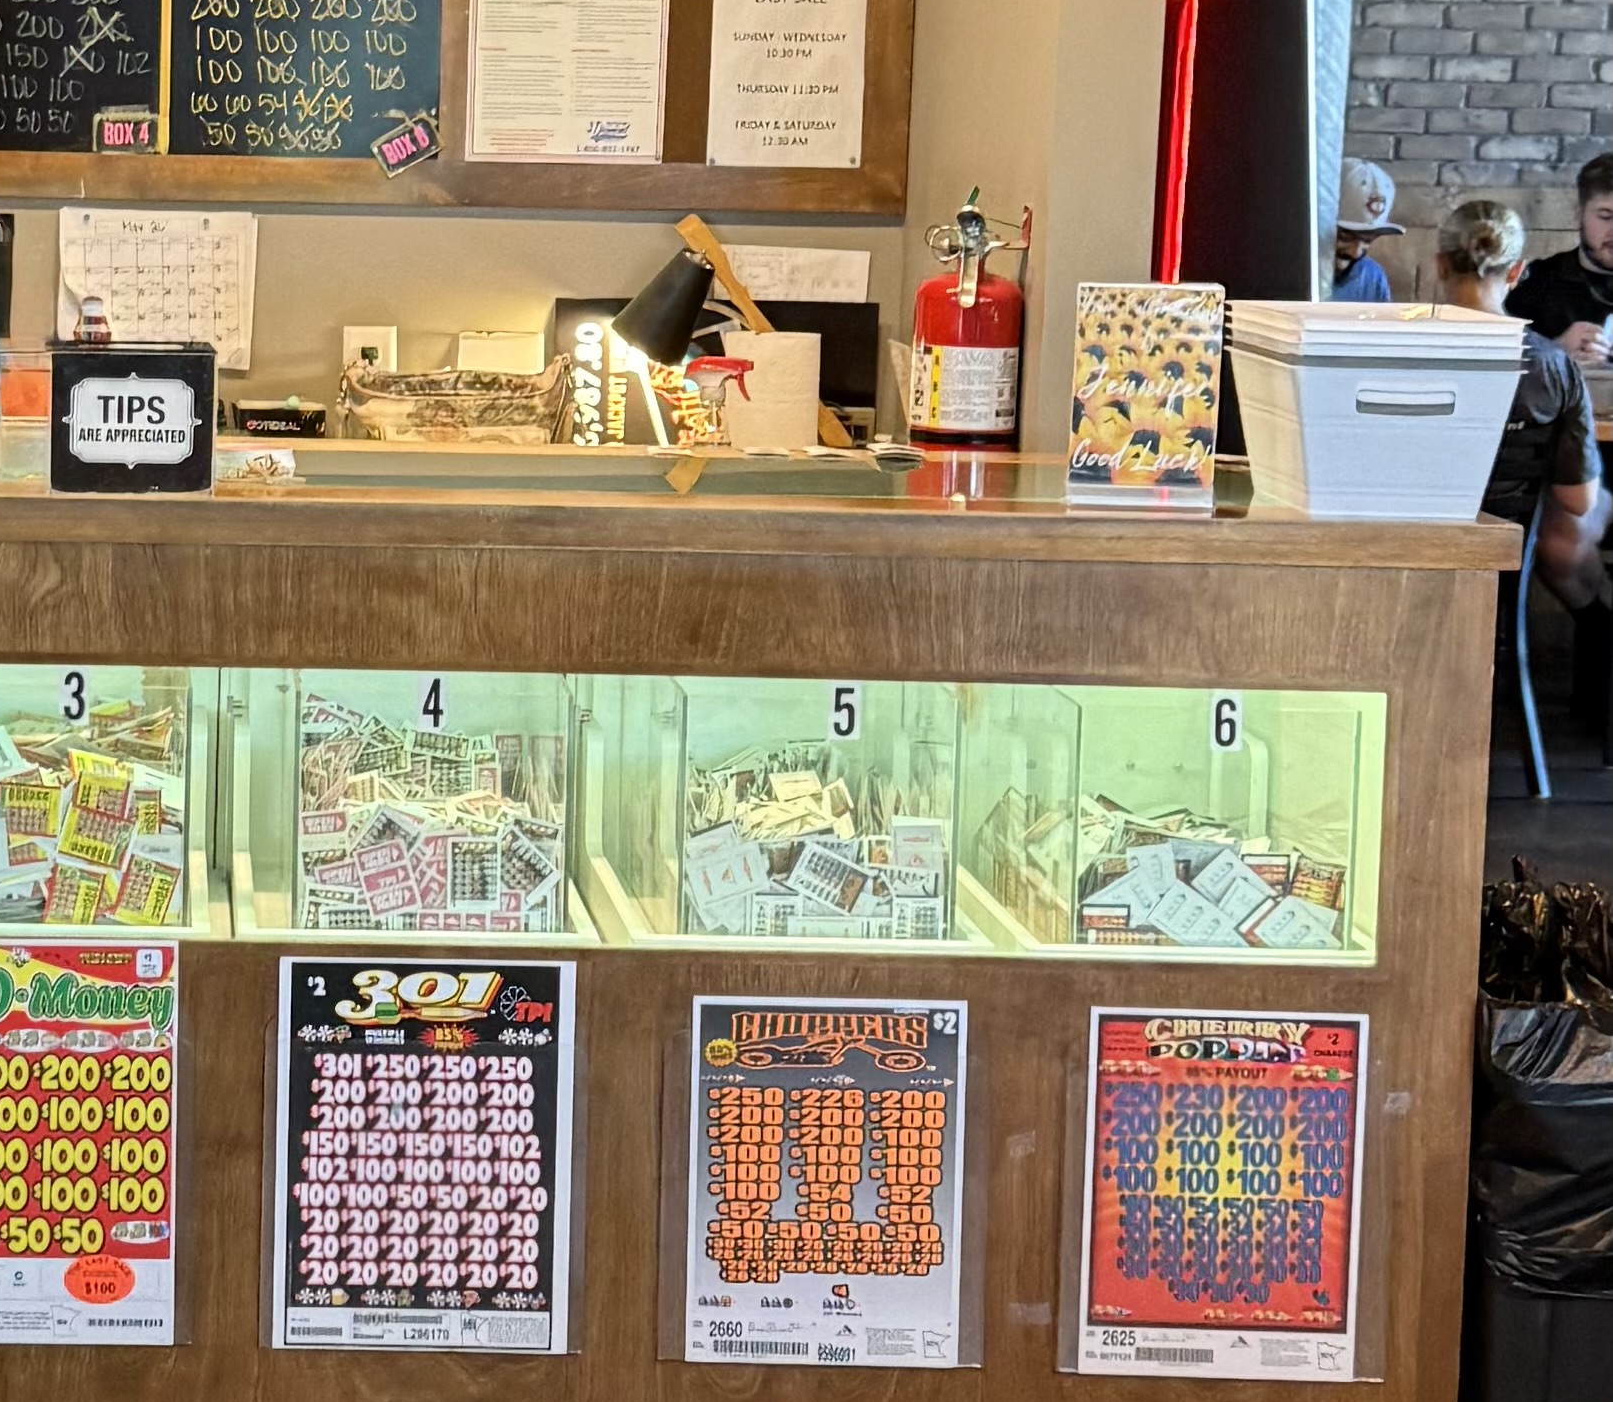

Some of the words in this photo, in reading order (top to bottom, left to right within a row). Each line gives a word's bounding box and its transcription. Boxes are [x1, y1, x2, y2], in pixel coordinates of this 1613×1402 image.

[784, 32, 847, 44] WEDNESDAY
[104, 122, 134, 144] BOX
[135, 123, 149, 144] 4
[1078, 363, 1210, 417] Jennifer
[97, 395, 165, 425] TIPS
[606, 375, 628, 439] JACKPOT
[78, 427, 102, 443] ARE
[106, 428, 186, 445] APPRECIATED
[1072, 439, 1128, 468] Good
[63, 672, 86, 719] 3
[421, 678, 443, 727] 4
[833, 687, 856, 737] 5
[1214, 698, 1239, 747] 6
[308, 975, 327, 996] $2
[335, 969, 503, 1025] 301
[933, 1012, 957, 1034] $2
[1144, 1018, 1312, 1045] CHERRY
[33, 1055, 101, 1092] $200
[104, 1055, 171, 1092] $200
[314, 1053, 362, 1078] $301
[366, 1053, 421, 1079] $250
[423, 1055, 476, 1080] $250
[478, 1056, 533, 1080] $250
[1216, 1067, 1268, 1080] PAYOUT
[708, 1320, 743, 1338] 2660
[1102, 1329, 1136, 1346] 2625
